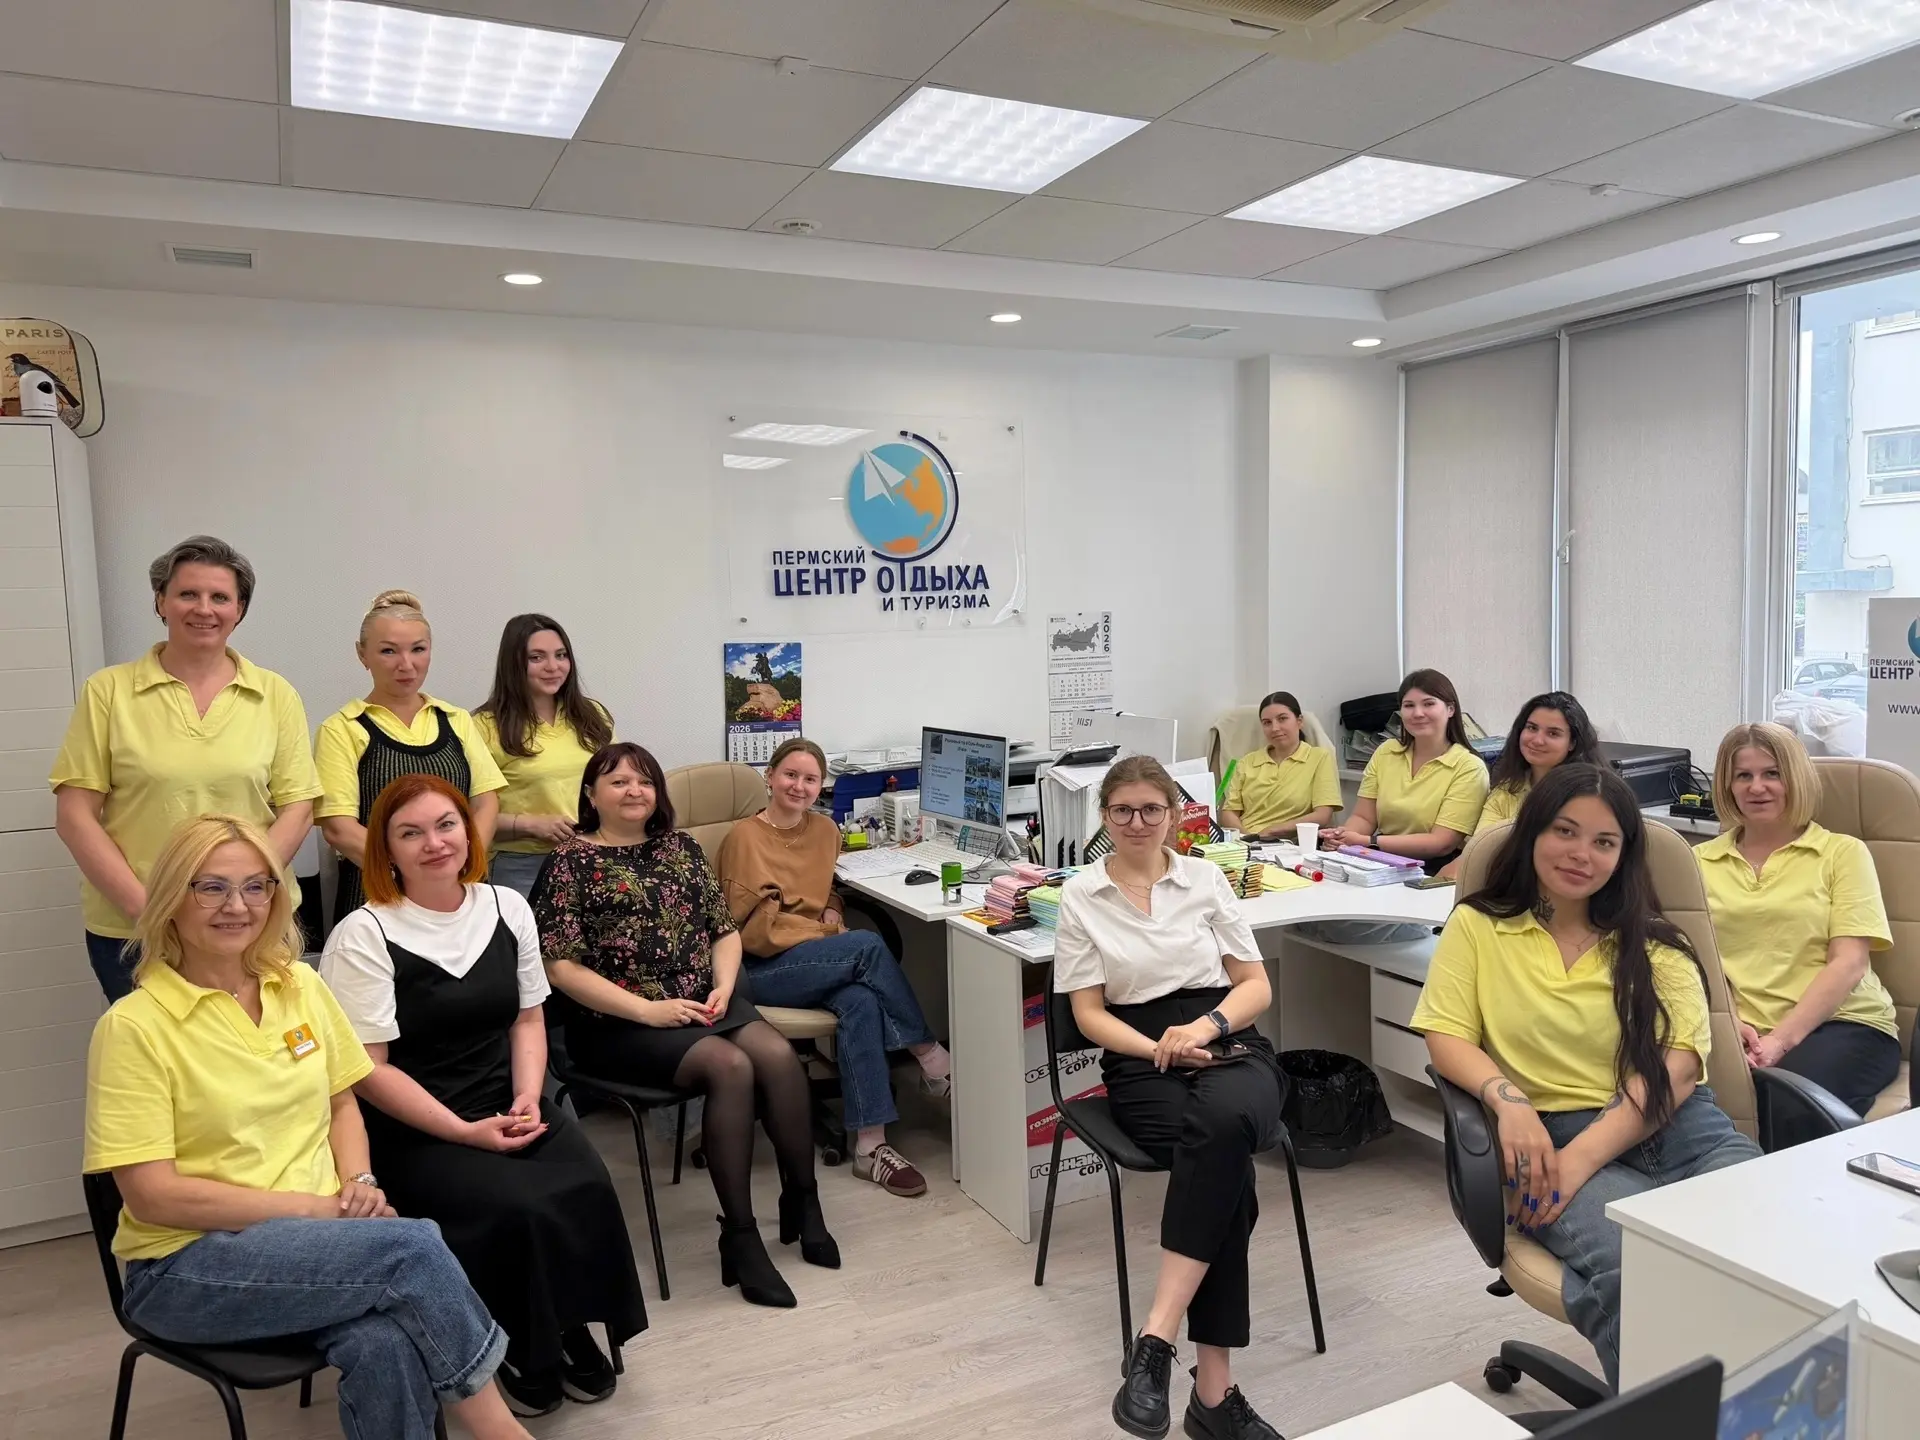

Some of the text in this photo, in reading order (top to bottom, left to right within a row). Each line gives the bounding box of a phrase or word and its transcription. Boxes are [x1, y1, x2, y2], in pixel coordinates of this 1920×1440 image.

[5, 328, 64, 339] PARIS
[772, 546, 866, 566] ПЕРМСКИЙ
[773, 562, 990, 597] ЦЕНТР ОТДЫХА
[882, 594, 991, 612] И ТУРИЗМА
[1870, 658, 1915, 667] ПЕРМСКИЙ
[1870, 667, 1914, 680] ЦЕНТР
[729, 725, 751, 734] 2026
[1065, 1054, 1097, 1075] COPY
[1079, 1162, 1107, 1176] COP
